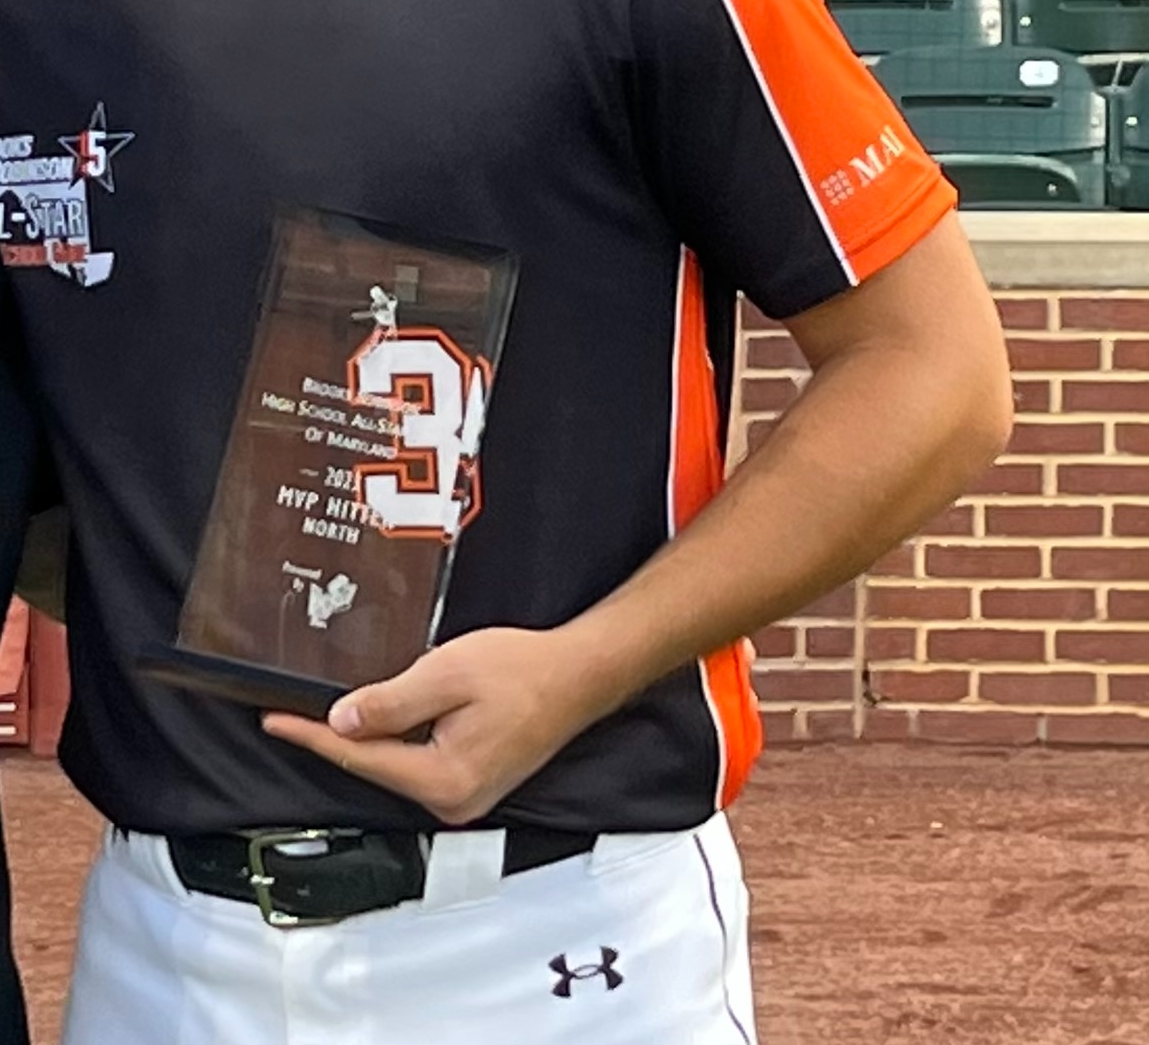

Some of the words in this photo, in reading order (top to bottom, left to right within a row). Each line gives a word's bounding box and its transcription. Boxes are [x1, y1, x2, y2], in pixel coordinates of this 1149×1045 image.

[87, 131, 107, 177] 5
[276, 484, 319, 511] MVP
[302, 516, 361, 545] NORTH
